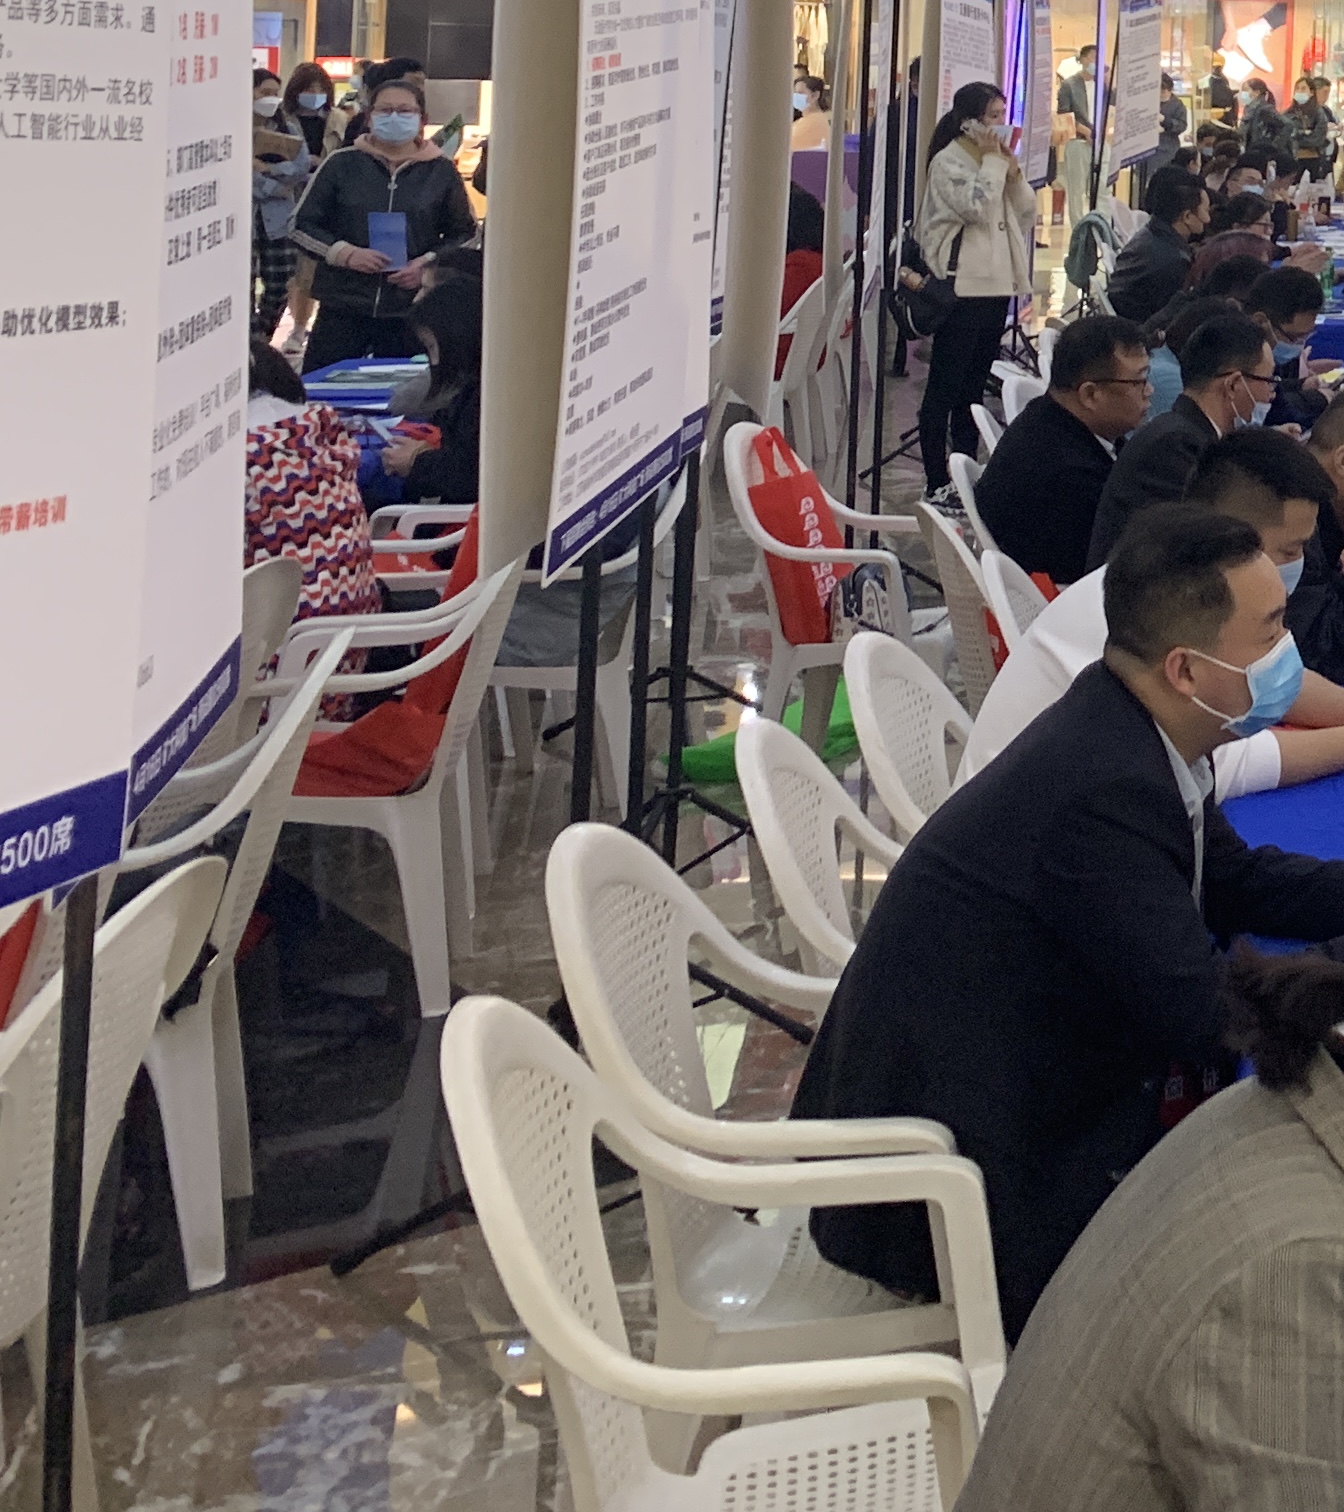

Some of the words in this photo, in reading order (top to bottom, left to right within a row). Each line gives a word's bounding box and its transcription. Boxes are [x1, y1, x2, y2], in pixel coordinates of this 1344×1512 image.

[0, 70, 154, 107] 学等国内外一流名校
[0, 492, 69, 535] 带薪培训
